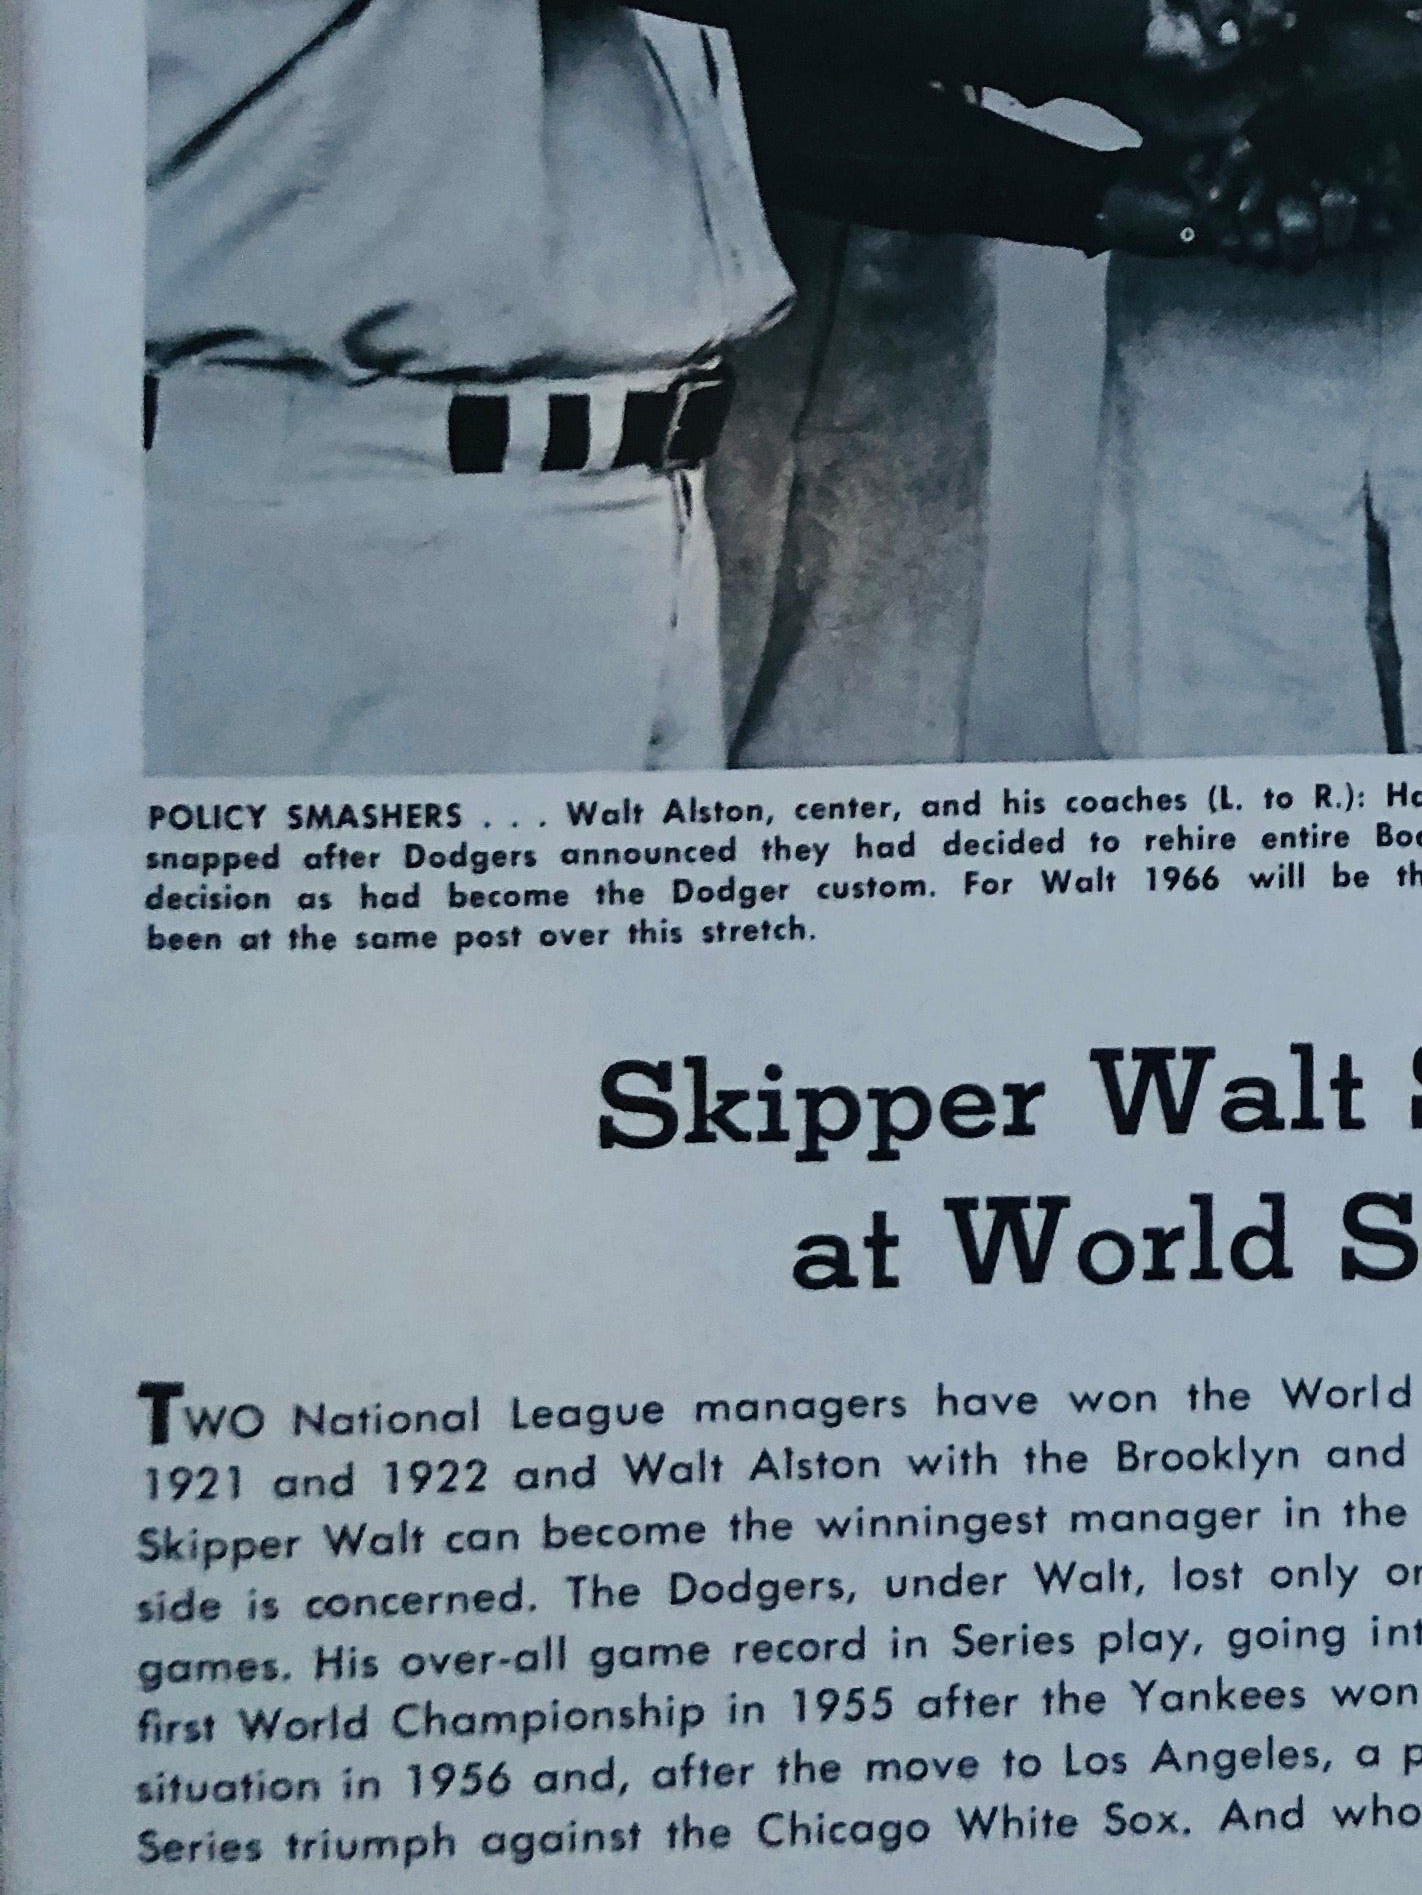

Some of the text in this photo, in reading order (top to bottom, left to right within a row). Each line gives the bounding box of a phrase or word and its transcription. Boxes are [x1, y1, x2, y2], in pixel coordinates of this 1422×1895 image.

[147, 803, 267, 832] POLICY
[286, 801, 463, 831] SMASHERS
[565, 797, 645, 827] Walt
[662, 795, 774, 827] Alston,
[794, 797, 901, 823] center,
[921, 789, 981, 819] and
[1003, 787, 1046, 815] his
[1065, 784, 1188, 814] coaches
[1207, 783, 1243, 815] (L.
[1263, 787, 1294, 811] to
[1314, 781, 1365, 813] R.):
[144, 882, 271, 911] decision
[296, 891, 333, 911] as
[359, 881, 421, 910] had
[448, 881, 570, 909] become
[595, 878, 645, 906] the
[672, 874, 790, 910] Dodger
[816, 876, 936, 900] custom.
[964, 870, 1014, 897] For
[1040, 865, 1117, 895] Walt
[1146, 865, 1220, 892] 1966
[1248, 861, 1305, 890] will
[1332, 860, 1370, 890] be
[145, 842, 281, 878] snapped
[303, 842, 381, 871] after
[404, 841, 538, 875] Dodgers
[559, 835, 737, 866] announced
[761, 834, 831, 868] they
[855, 830, 916, 860] had
[942, 826, 1065, 857] decided
[1089, 831, 1121, 854] to
[1145, 823, 1237, 852] rehire
[1260, 822, 1350, 850] entire
[599, 1055, 1045, 1162] Skipper
[1090, 1043, 1366, 1135] Walt
[793, 1211, 899, 1290] at
[944, 1192, 1293, 1285] World
[145, 1465, 241, 1502] 1921
[272, 1460, 354, 1500] and
[385, 1457, 488, 1496] 1922
[513, 1453, 597, 1492] and
[622, 1447, 724, 1486] Walt
[748, 1446, 881, 1482] Alston
[906, 1440, 998, 1477] with
[1023, 1439, 1089, 1476] the
[1116, 1434, 1300, 1481] Brooklyn
[1326, 1432, 1405, 1469] and
[137, 1657, 292, 1694] games.
[314, 1644, 379, 1682] His
[399, 1634, 566, 1679] over-all
[589, 1640, 711, 1679] game
[734, 1624, 866, 1665] record
[891, 1625, 928, 1660] in
[951, 1622, 1075, 1659] Series
[1098, 1617, 1203, 1666] play,
[1227, 1615, 1346, 1661] going
[137, 1828, 263, 1866] Series
[285, 1820, 456, 1870] triumph
[481, 1819, 642, 1866] against
[666, 1812, 732, 1851] the
[757, 1809, 931, 1855] Chicago
[955, 1802, 1079, 1842] White
[1103, 1801, 1191, 1838] Sox.
[1218, 1793, 1305, 1834] And
